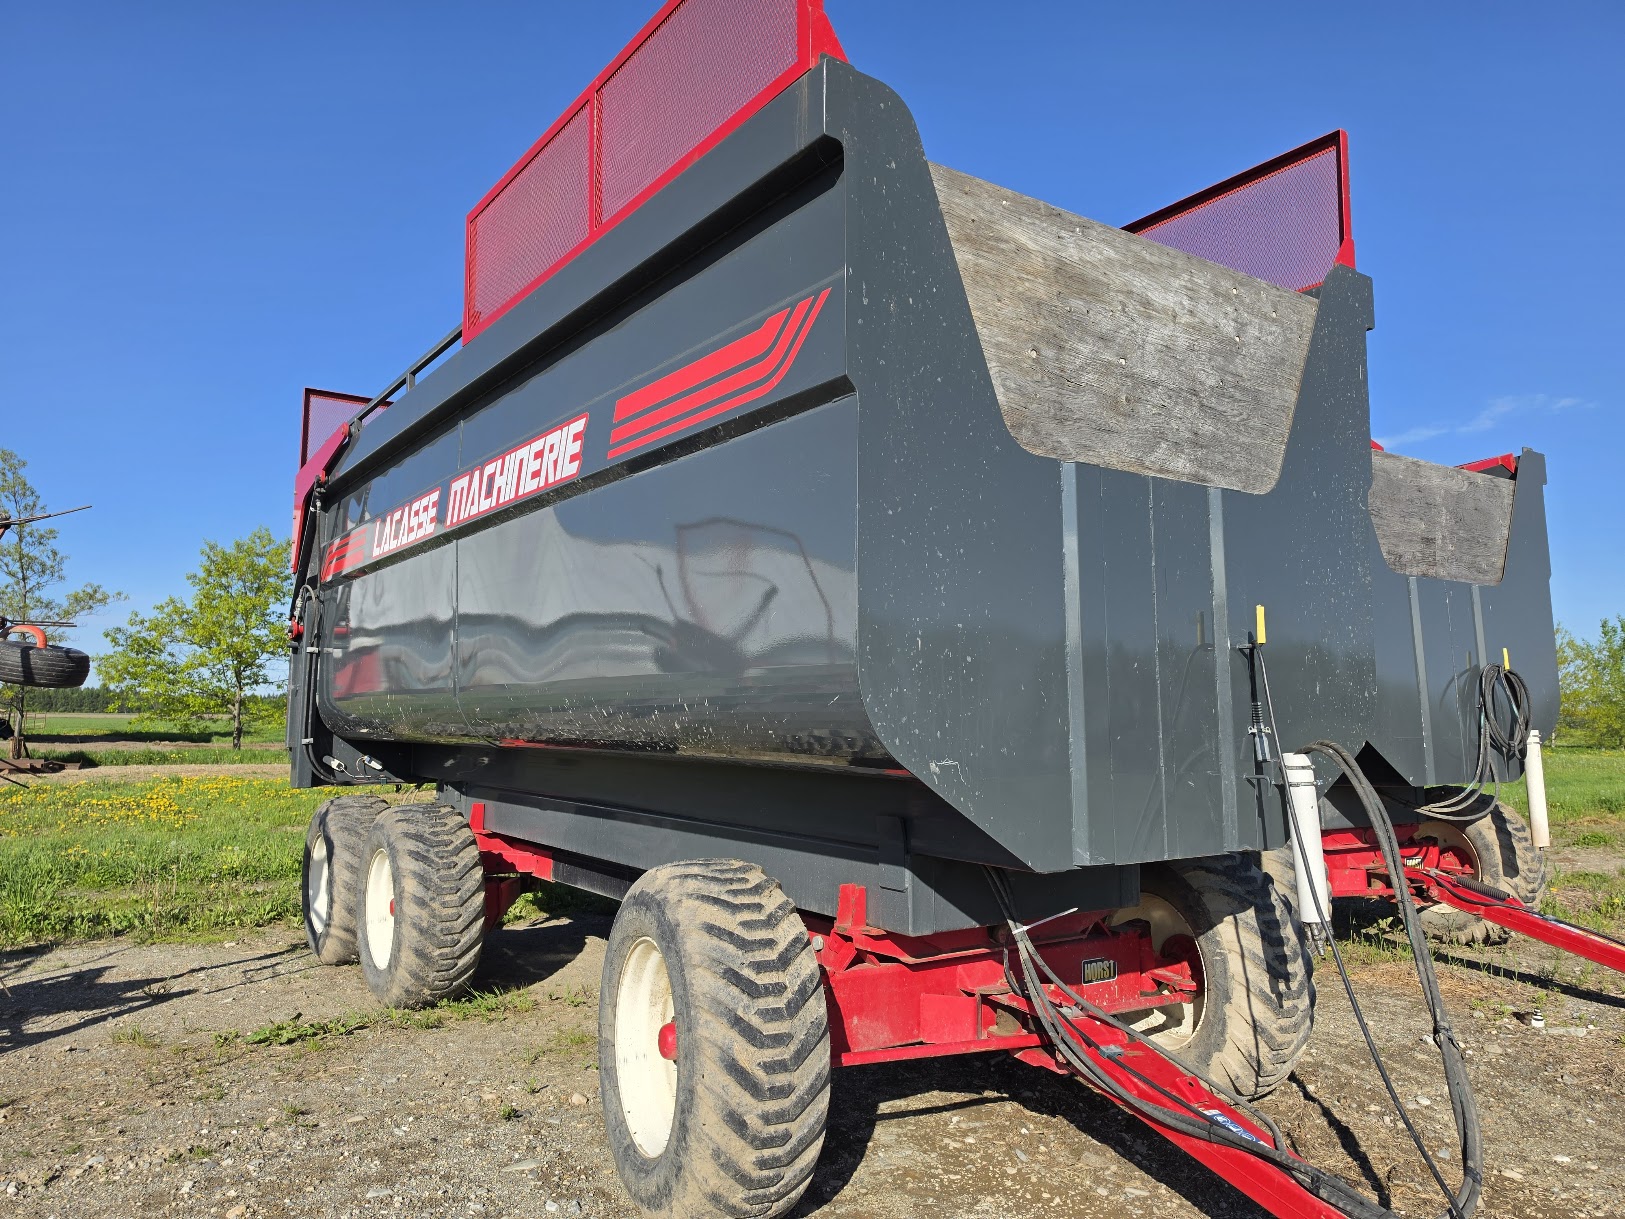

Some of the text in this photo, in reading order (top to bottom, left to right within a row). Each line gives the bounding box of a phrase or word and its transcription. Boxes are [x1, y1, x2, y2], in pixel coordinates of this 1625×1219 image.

[372, 416, 587, 557] LACASSE MACHINERIE
[1084, 960, 1114, 981] HORST
